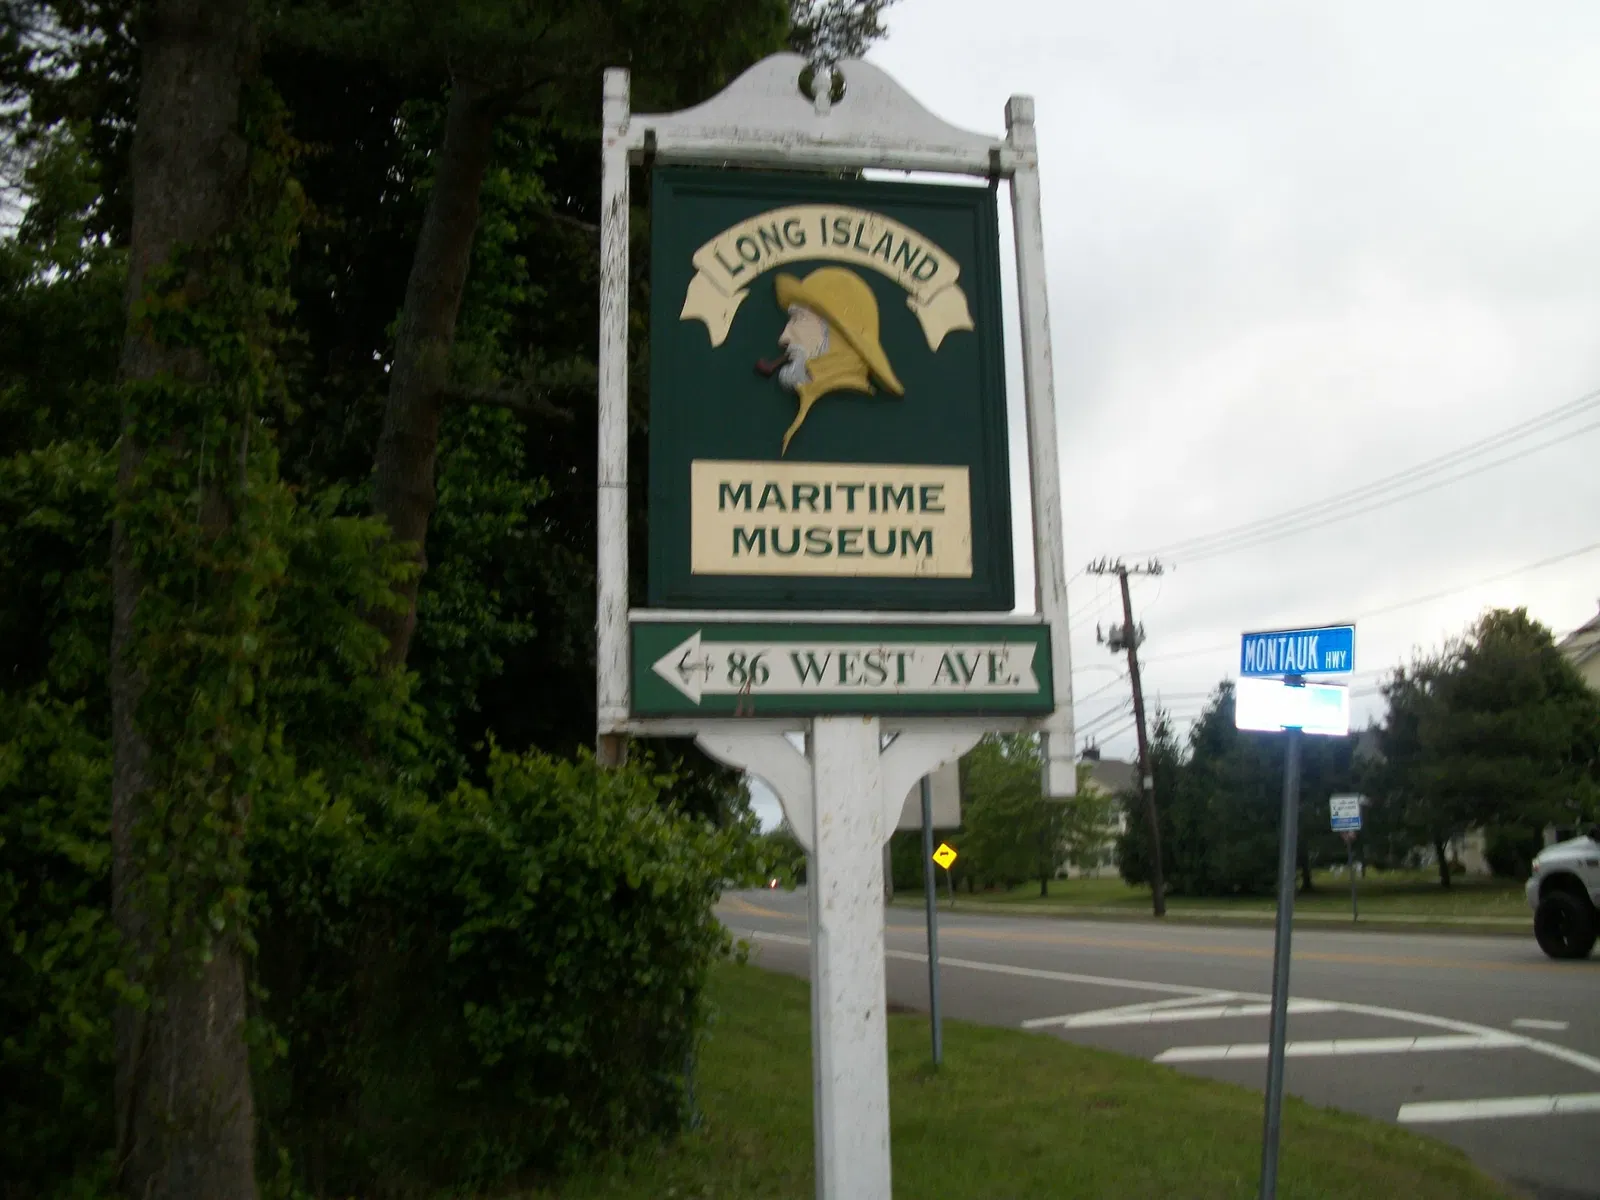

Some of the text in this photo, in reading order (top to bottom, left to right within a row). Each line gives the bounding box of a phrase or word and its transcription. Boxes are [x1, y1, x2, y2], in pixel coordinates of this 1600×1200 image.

[714, 215, 939, 283] LONG ISLAND
[717, 482, 946, 514] MARITIME
[732, 527, 934, 558] MUSEUM
[727, 648, 1021, 687] 86 WEST AVE.
[1244, 635, 1347, 671] MONTAUK HWY
